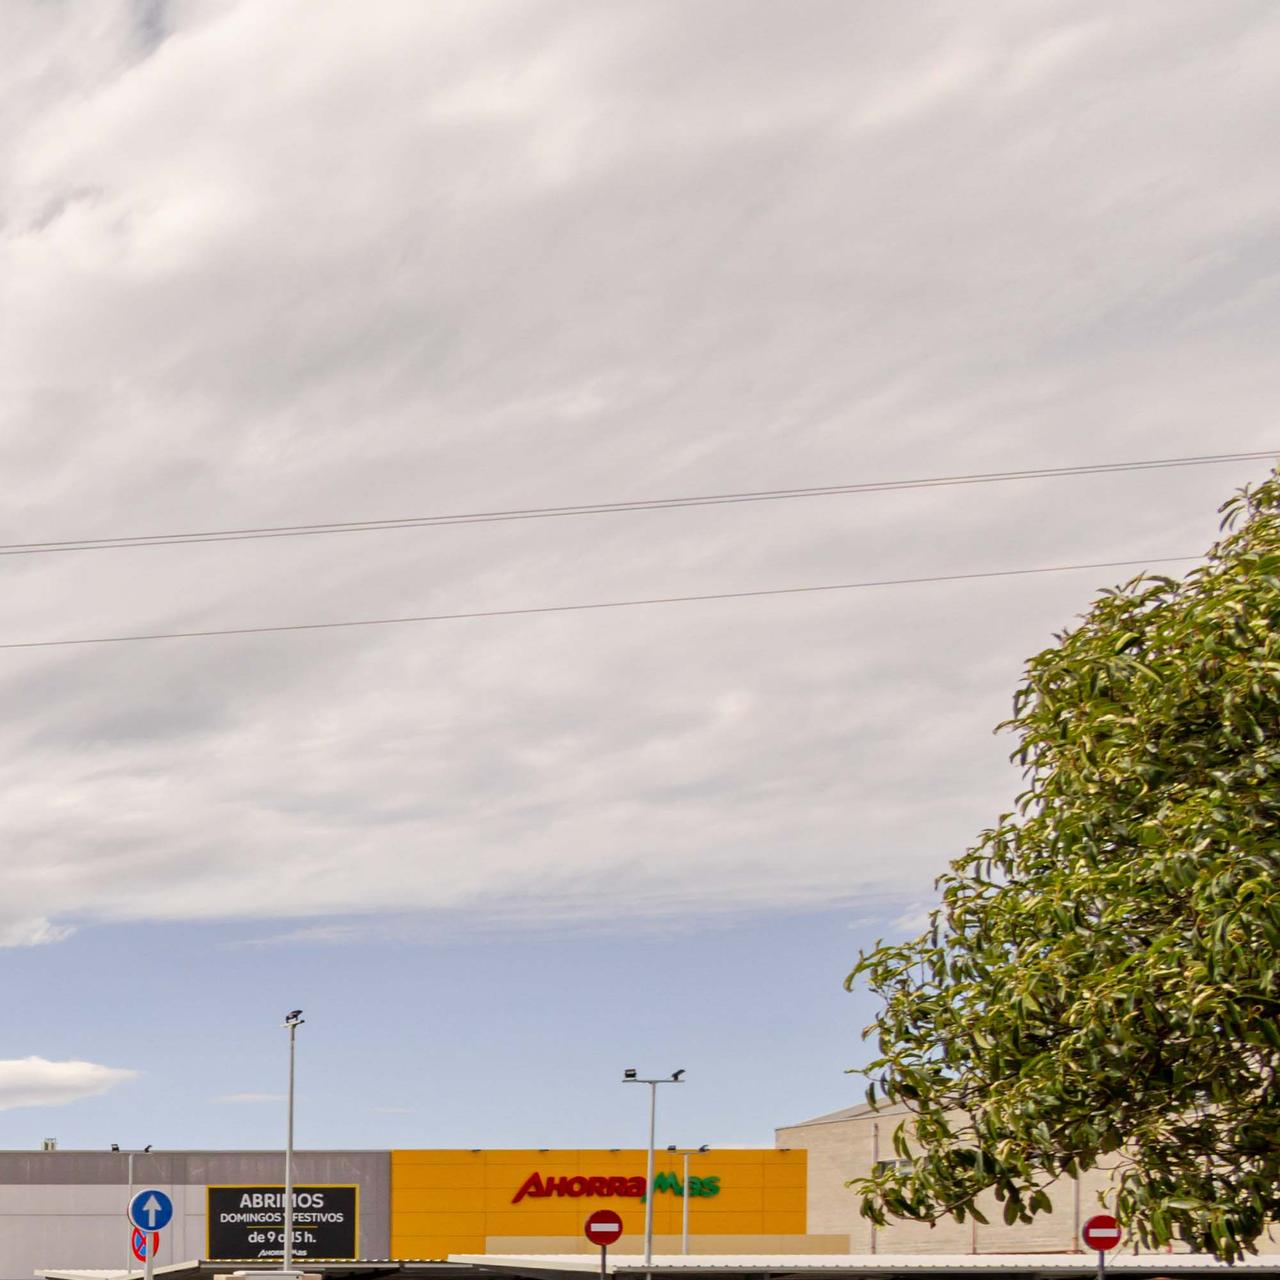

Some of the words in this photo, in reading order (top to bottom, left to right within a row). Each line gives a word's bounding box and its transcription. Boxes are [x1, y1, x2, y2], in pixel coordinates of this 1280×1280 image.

[220, 1212, 282, 1223] DOMINGOS
[291, 1212, 344, 1223] FESTIVOS
[247, 1231, 266, 1243] de
[266, 1231, 276, 1243] 9
[291, 1231, 303, 1243] 15
[304, 1231, 317, 1243] h.
